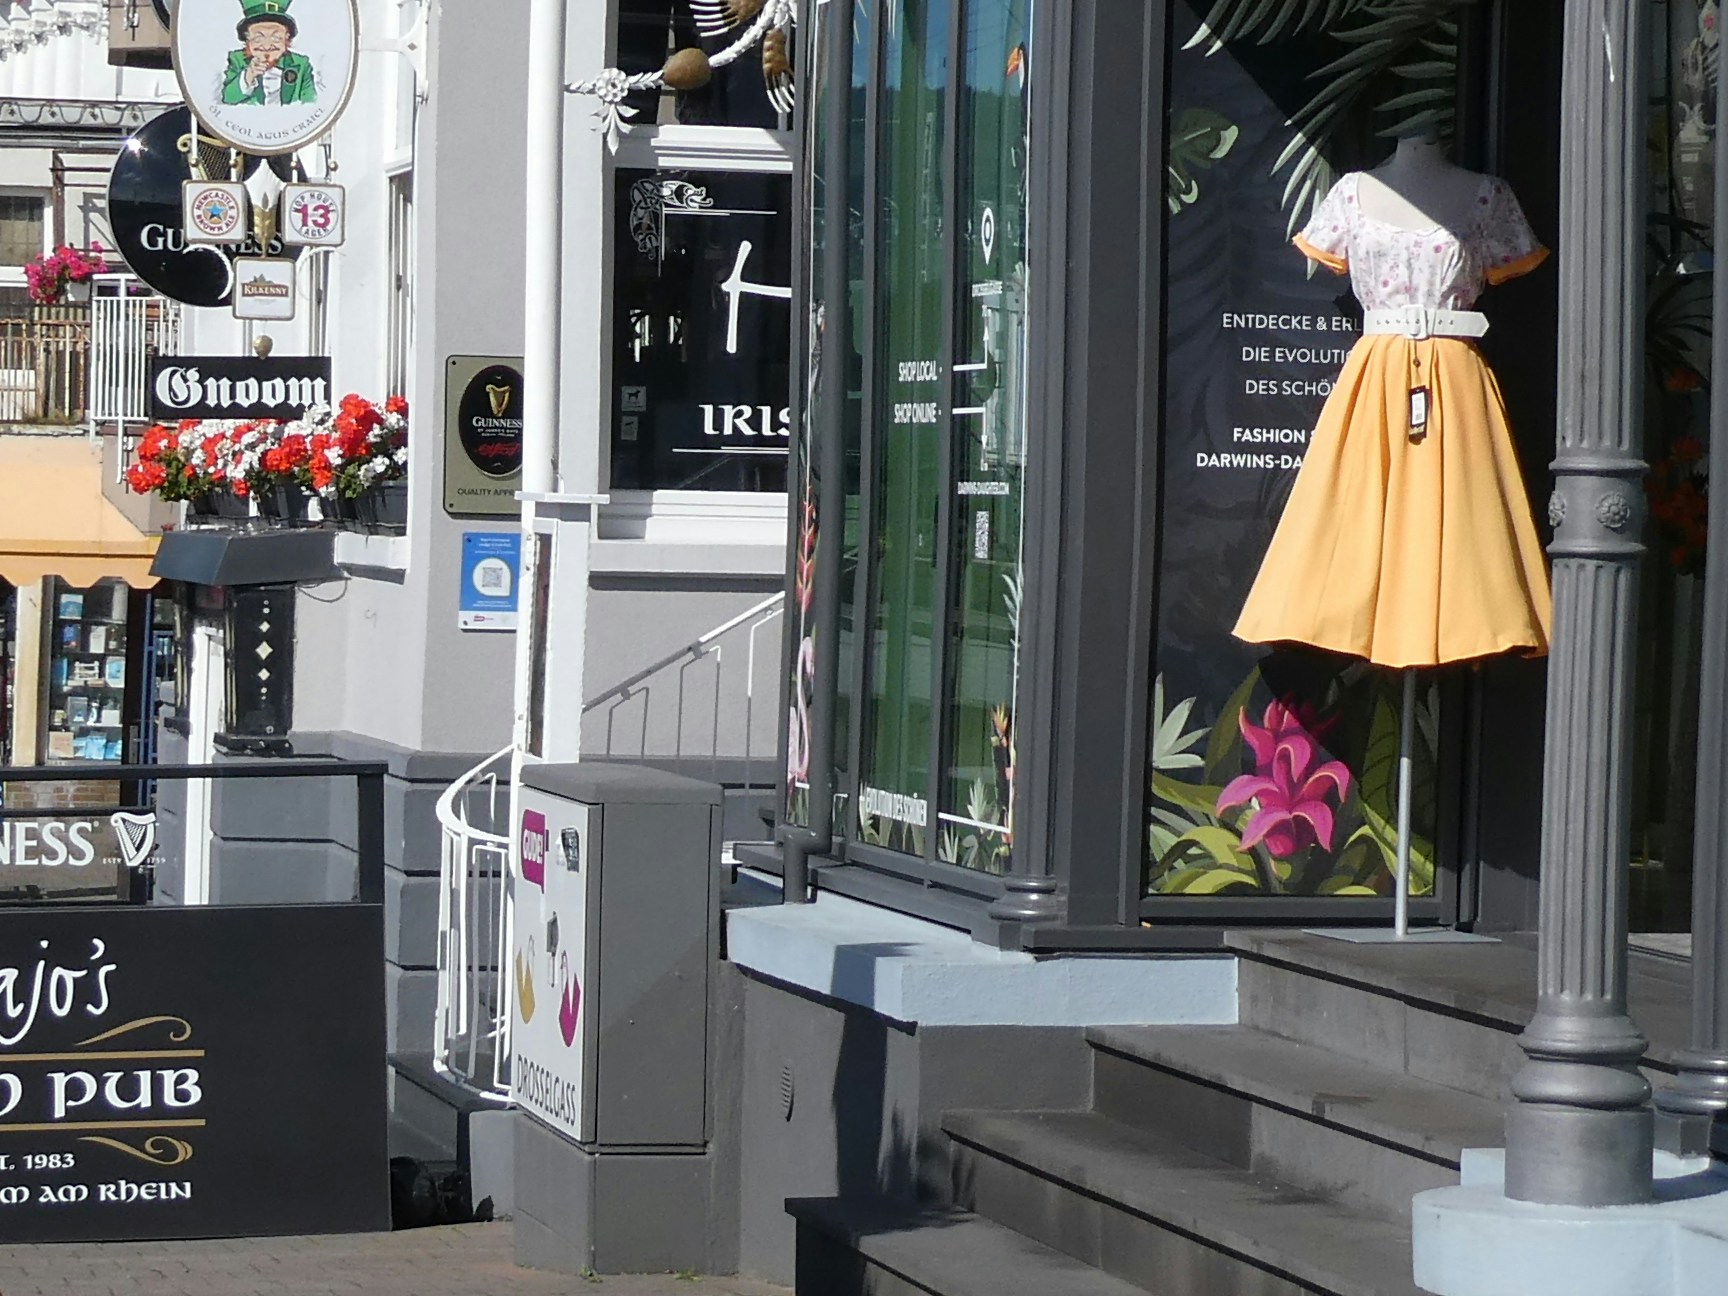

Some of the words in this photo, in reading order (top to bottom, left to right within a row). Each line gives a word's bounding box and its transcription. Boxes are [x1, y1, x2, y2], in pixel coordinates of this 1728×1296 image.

[299, 204, 331, 228] 13
[244, 283, 288, 296] KILKENNY
[1222, 313, 1312, 330] ENTDECKE
[1316, 316, 1328, 331] &
[1242, 347, 1270, 362] DIE
[898, 361, 916, 382] SHOP
[916, 360, 938, 381] LOCAL
[156, 366, 328, 409] Gnoom
[1245, 380, 1277, 394] DES
[894, 403, 913, 424] SHOP
[913, 402, 937, 424] ONLINE
[472, 416, 522, 428] GUINNESS
[1233, 428, 1306, 443] FASHION
[1196, 453, 1304, 469] DARWINS-DA
[457, 487, 492, 496] QUALITY
[46, 1067, 203, 1120] PUB
[23, 1153, 76, 1169] 1983
